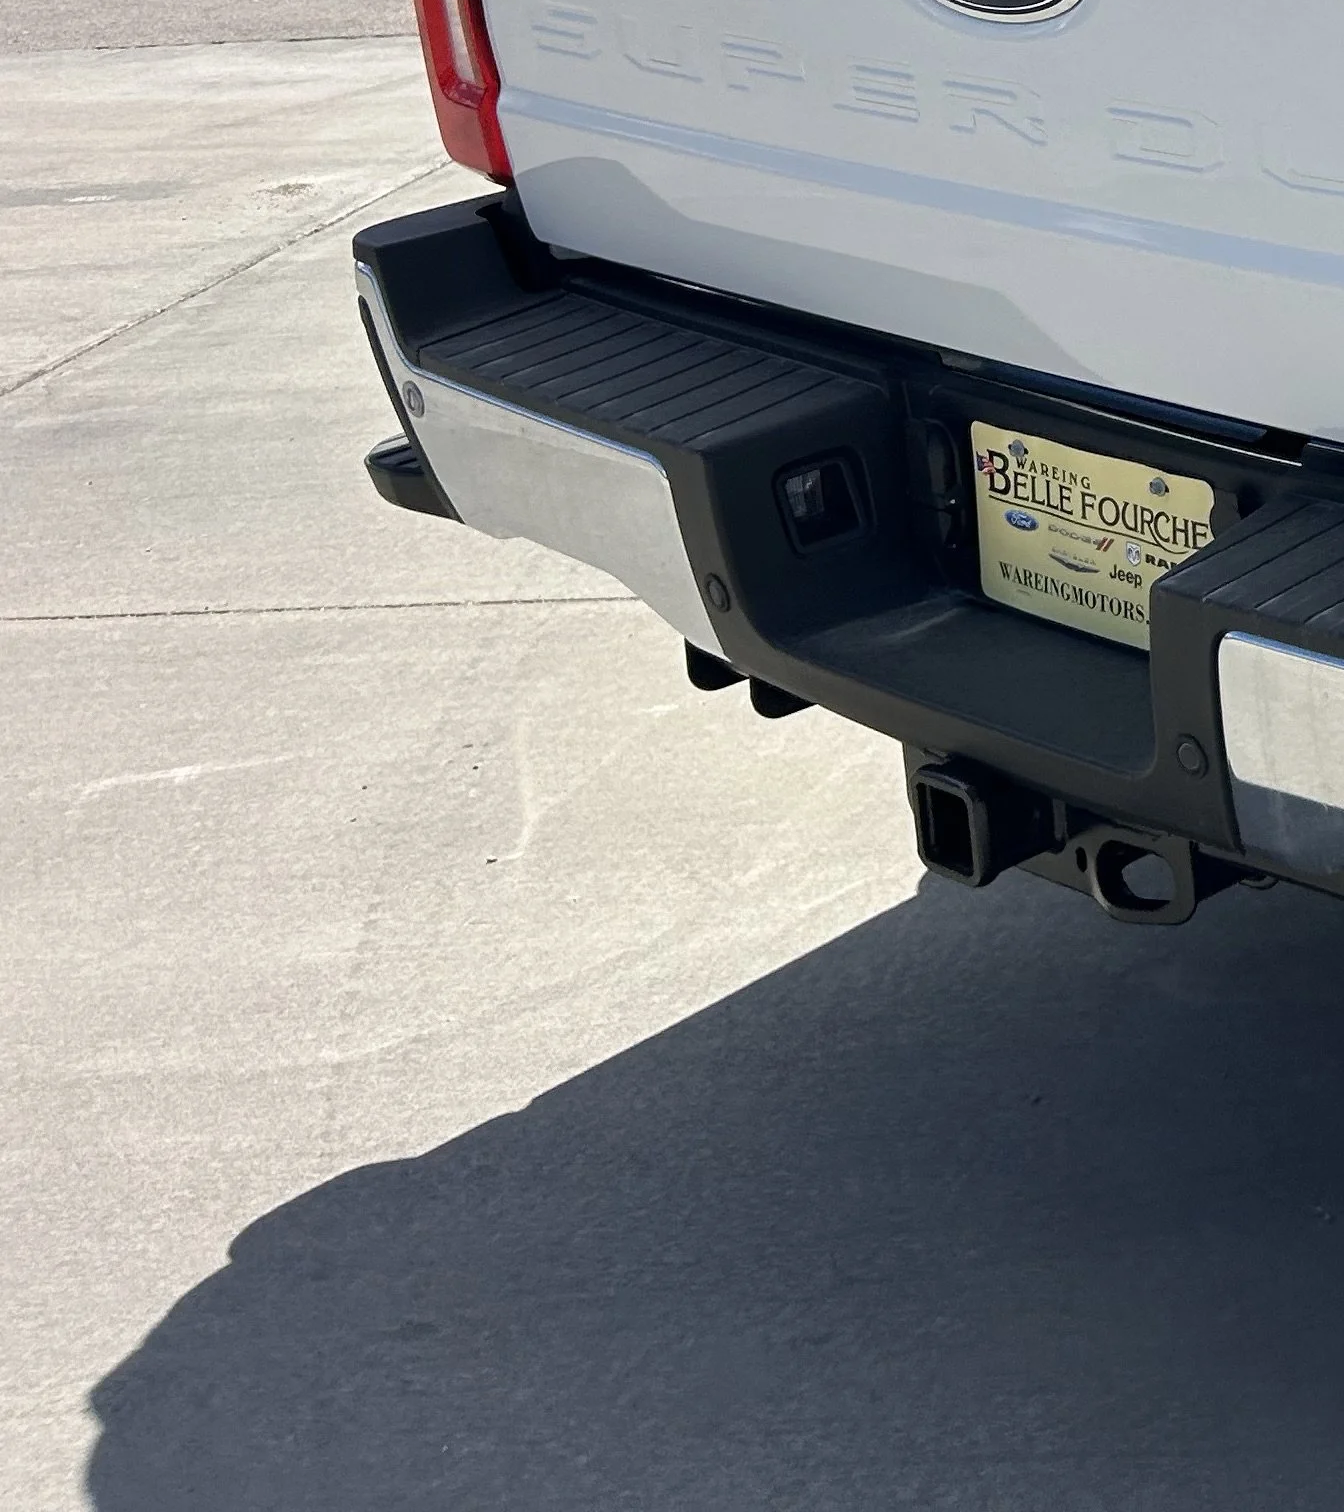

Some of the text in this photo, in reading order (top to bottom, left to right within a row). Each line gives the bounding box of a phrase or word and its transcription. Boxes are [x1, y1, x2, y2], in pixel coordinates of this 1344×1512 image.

[530, 1, 1048, 148] SUPER
[986, 448, 1209, 554] BELLE FOURCHE
[1015, 454, 1091, 490] WAREING
[998, 560, 1151, 625] WAREINGMOTORS.
[1109, 563, 1143, 589] Jeep
